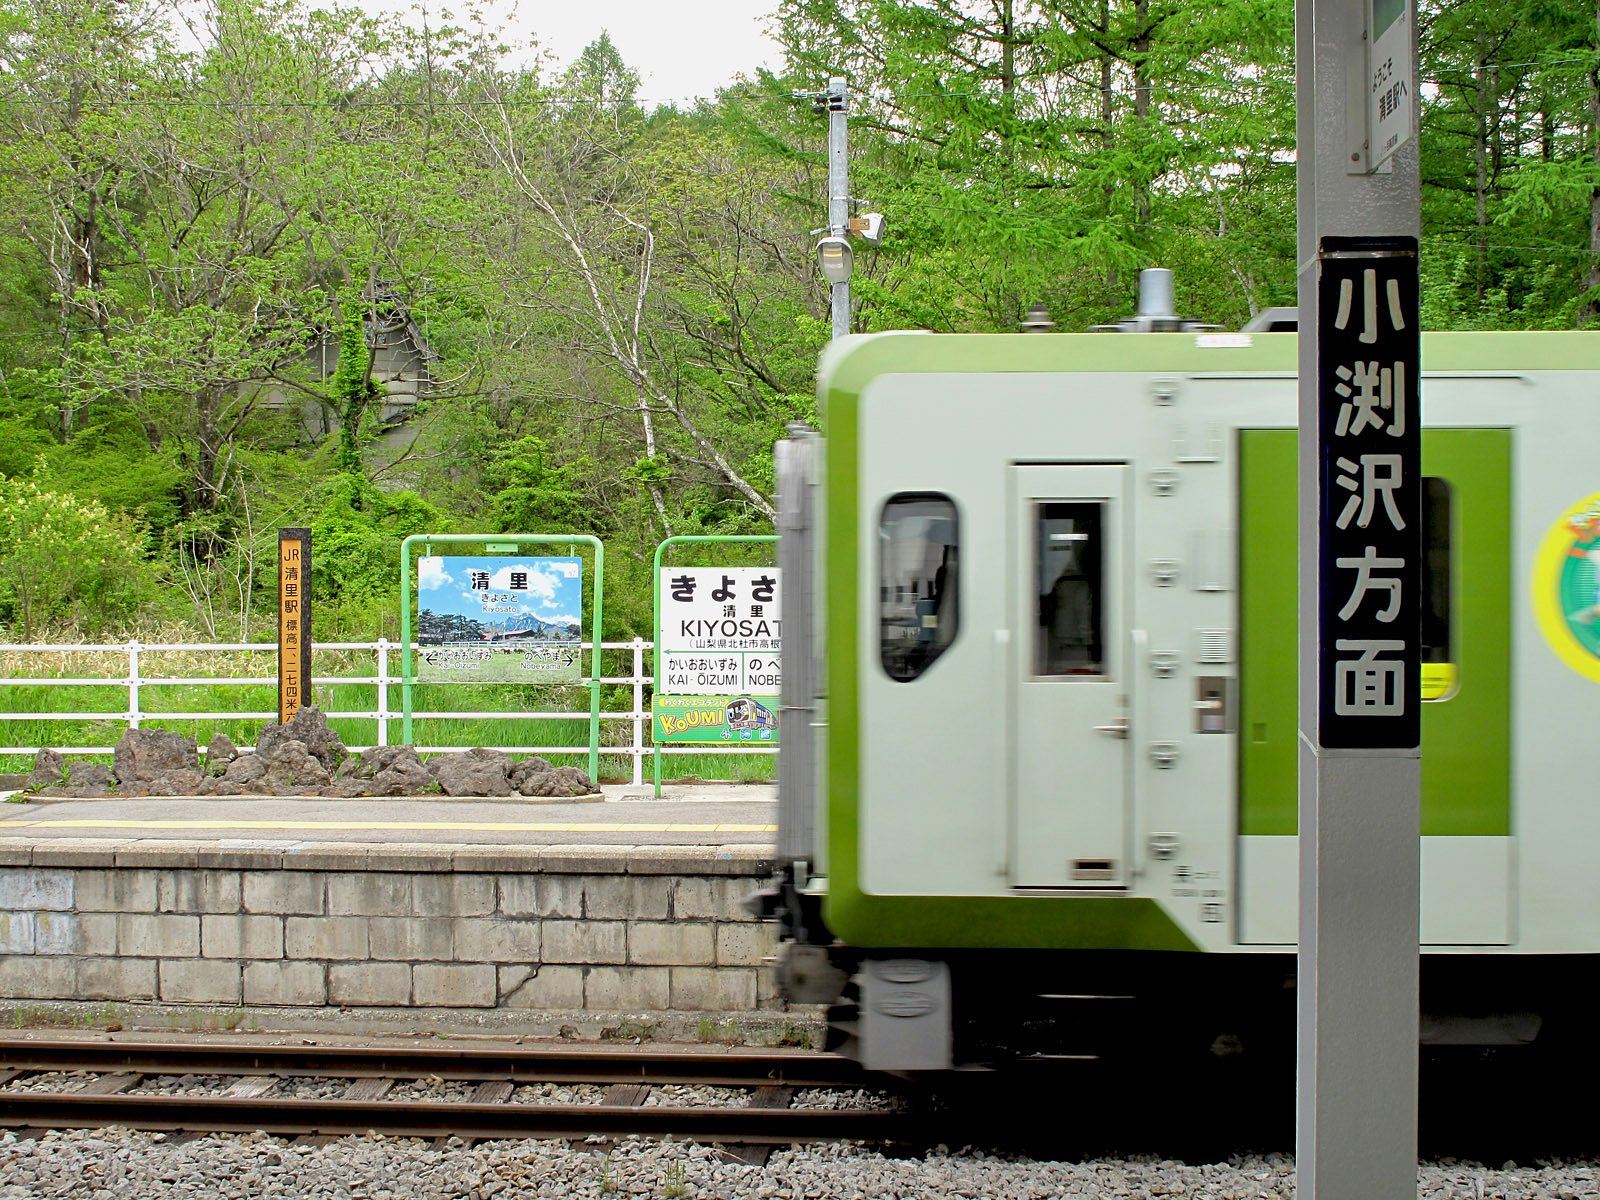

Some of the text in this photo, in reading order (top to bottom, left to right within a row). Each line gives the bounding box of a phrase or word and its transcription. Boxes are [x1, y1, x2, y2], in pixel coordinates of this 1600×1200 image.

[1334, 268, 1406, 717] 小渕沢方面
[471, 572, 528, 590] 清里
[670, 575, 777, 602] きよさ
[481, 593, 518, 603] きよさと
[482, 605, 517, 613] Kiyosato
[723, 604, 764, 617] 清里
[520, 662, 561, 670] Nobeyama
[668, 657, 738, 671] かいおおいずみ
[748, 674, 782, 686] NOBE
